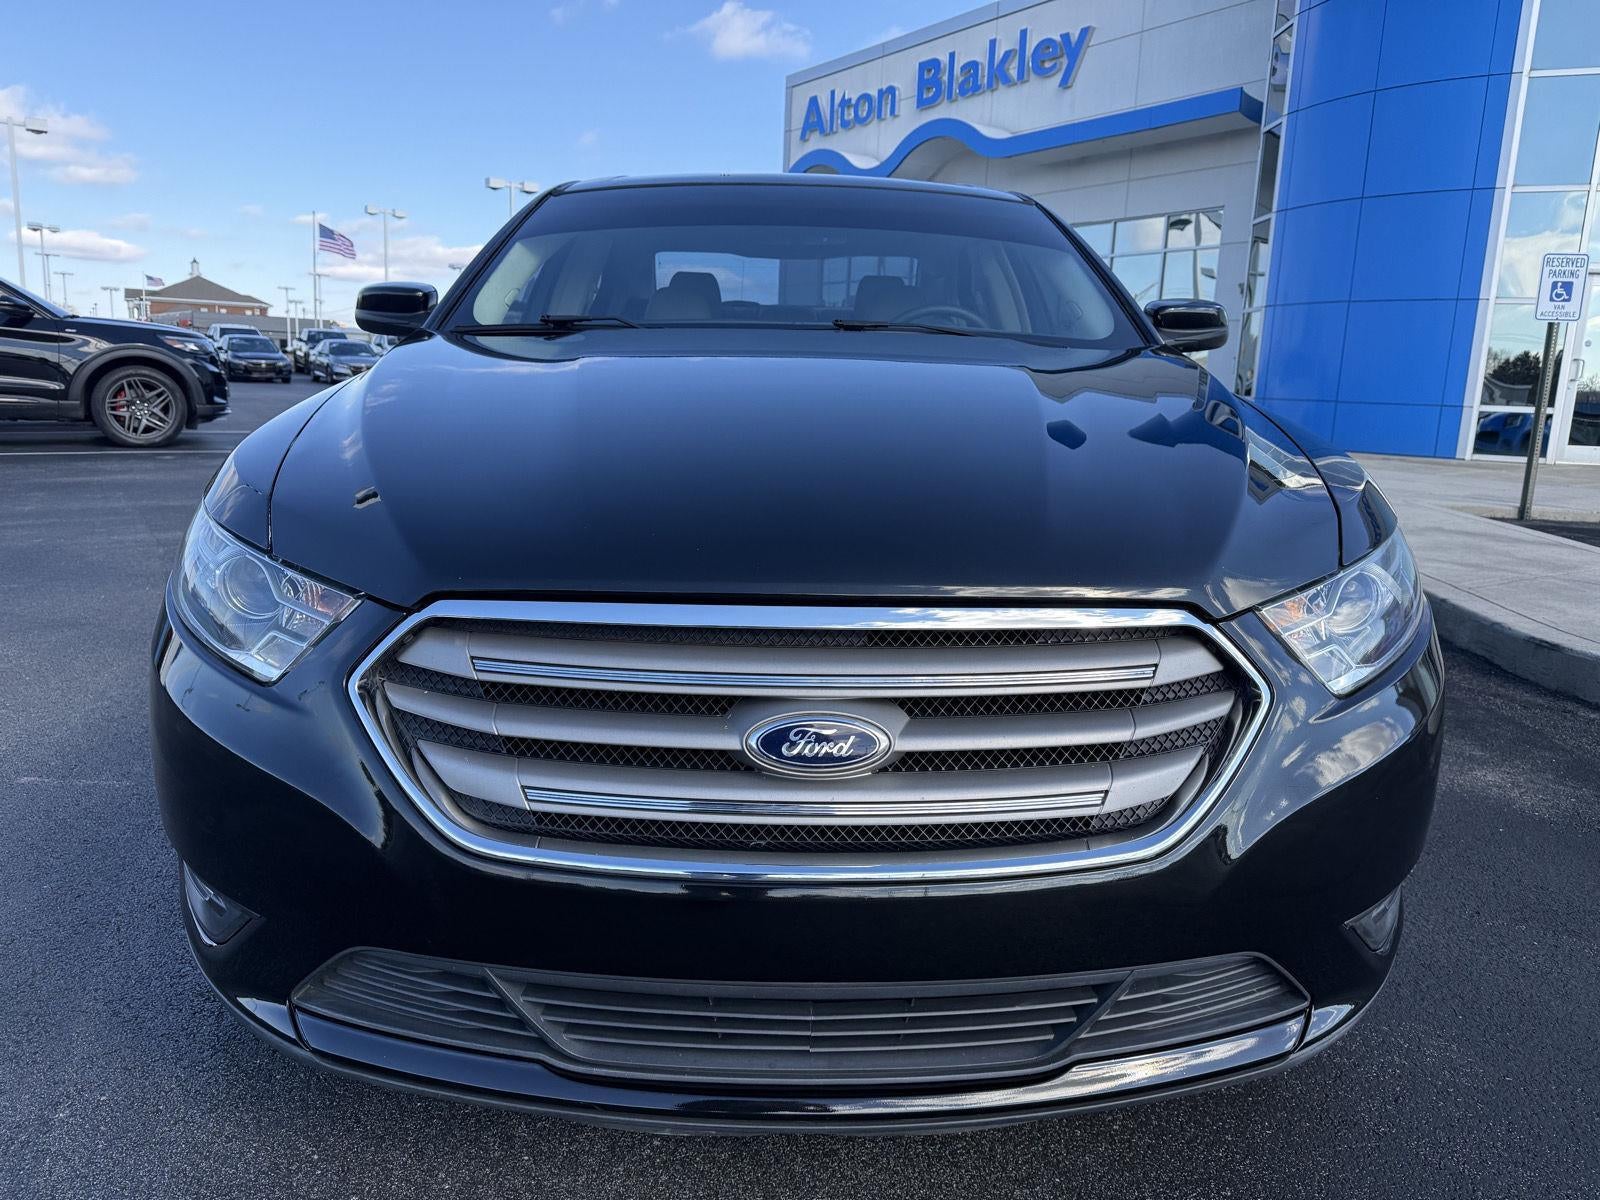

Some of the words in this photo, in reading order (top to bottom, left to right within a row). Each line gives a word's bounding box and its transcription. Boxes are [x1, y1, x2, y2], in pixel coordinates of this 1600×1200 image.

[800, 83, 898, 142] Alton
[915, 25, 1094, 109] Blakley
[1545, 257, 1586, 268] RESERVED
[1548, 268, 1580, 279] PARKING
[781, 727, 854, 757] Ford
